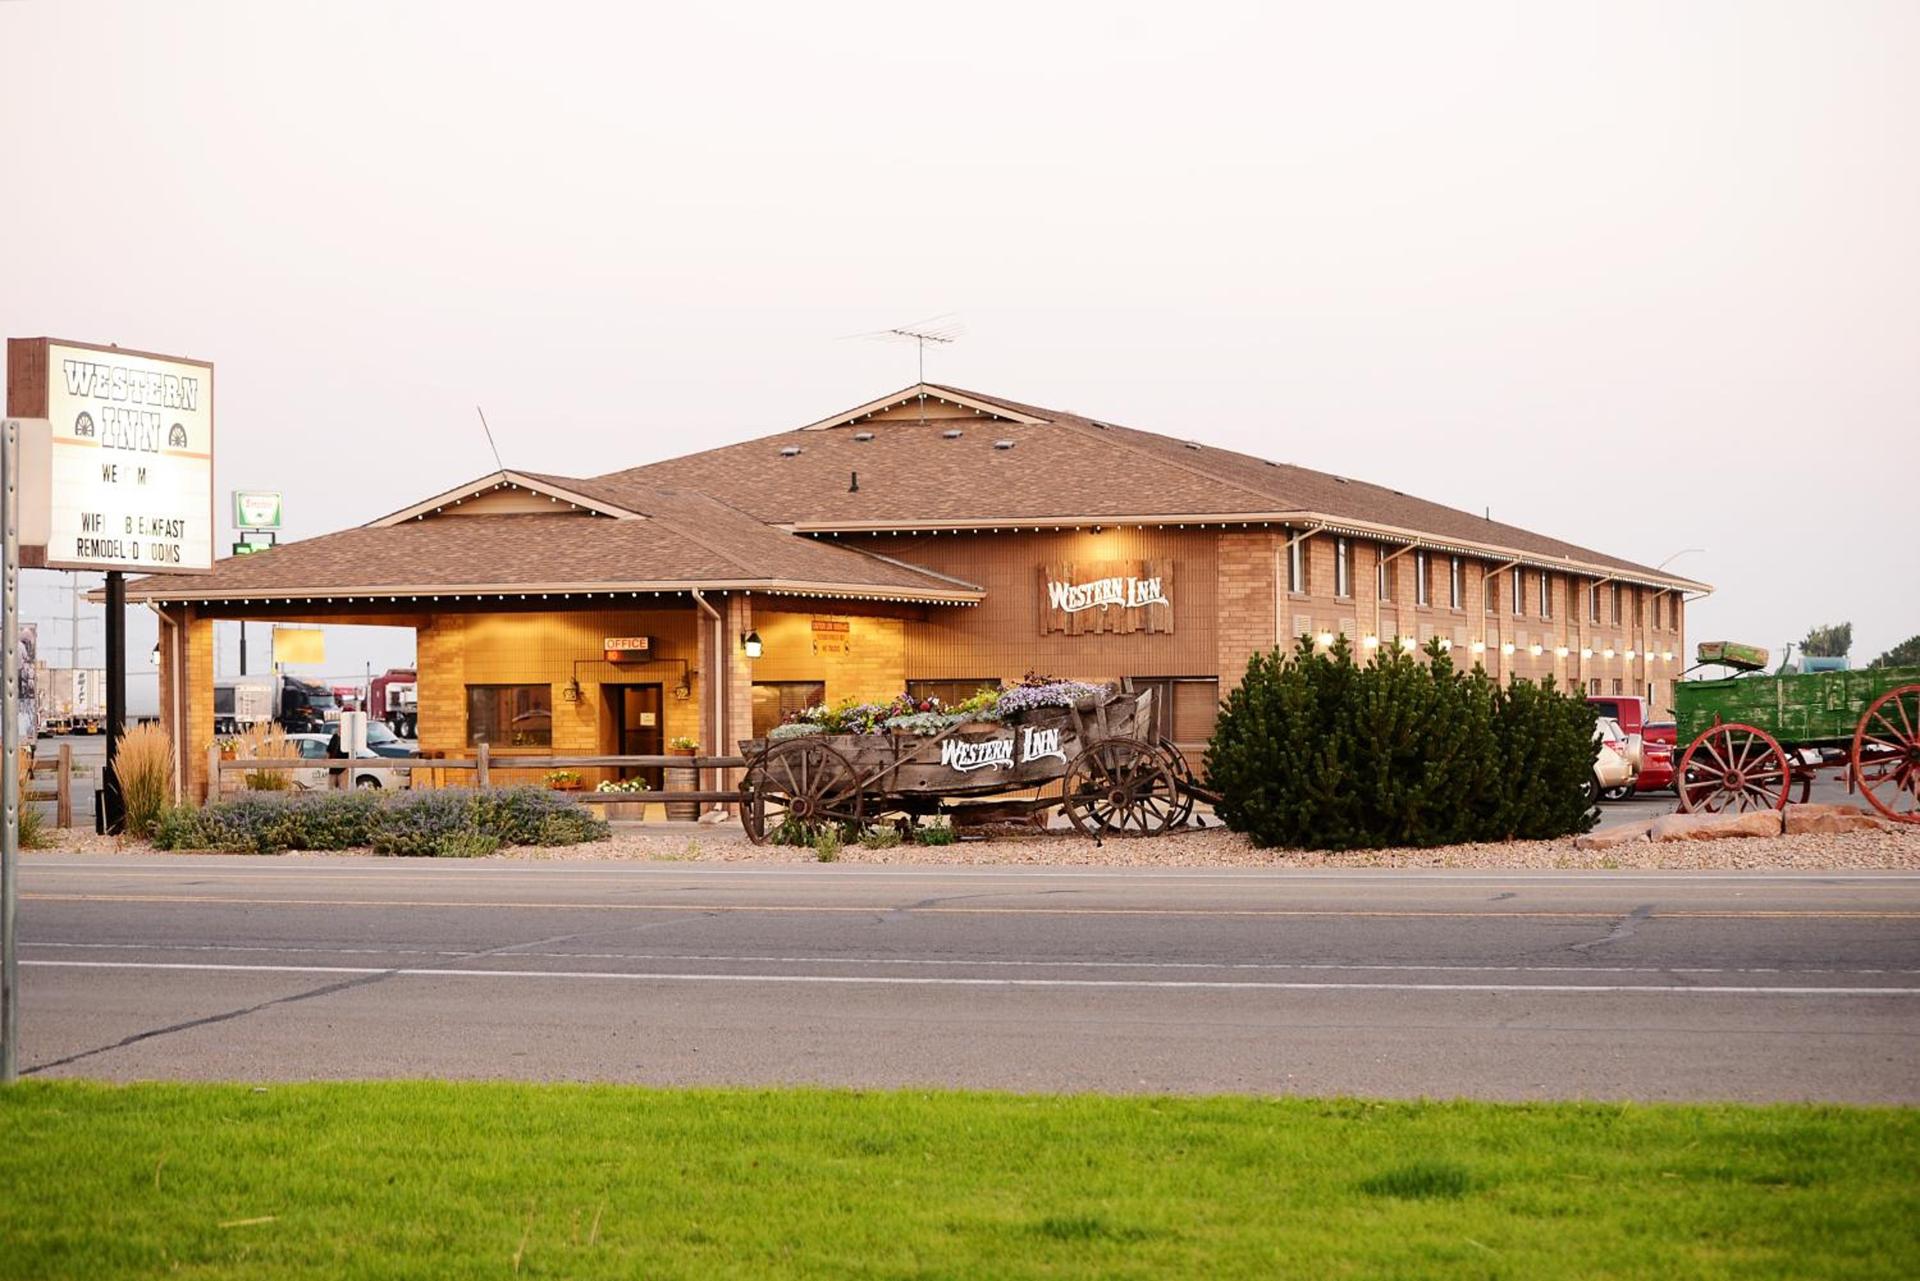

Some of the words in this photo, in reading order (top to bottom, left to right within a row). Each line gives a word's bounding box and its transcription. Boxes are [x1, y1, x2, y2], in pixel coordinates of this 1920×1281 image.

[63, 359, 198, 411] WESTERN
[102, 406, 160, 453] INN
[125, 516, 185, 539] BEKFAST
[77, 538, 139, 560] REMODELD
[147, 542, 180, 563] OOMS
[1047, 577, 1125, 613] WESTERN
[1126, 576, 1170, 609] INN
[607, 639, 647, 648] OFFICE
[940, 738, 1015, 773] WESTERN
[1021, 726, 1067, 765] INN
